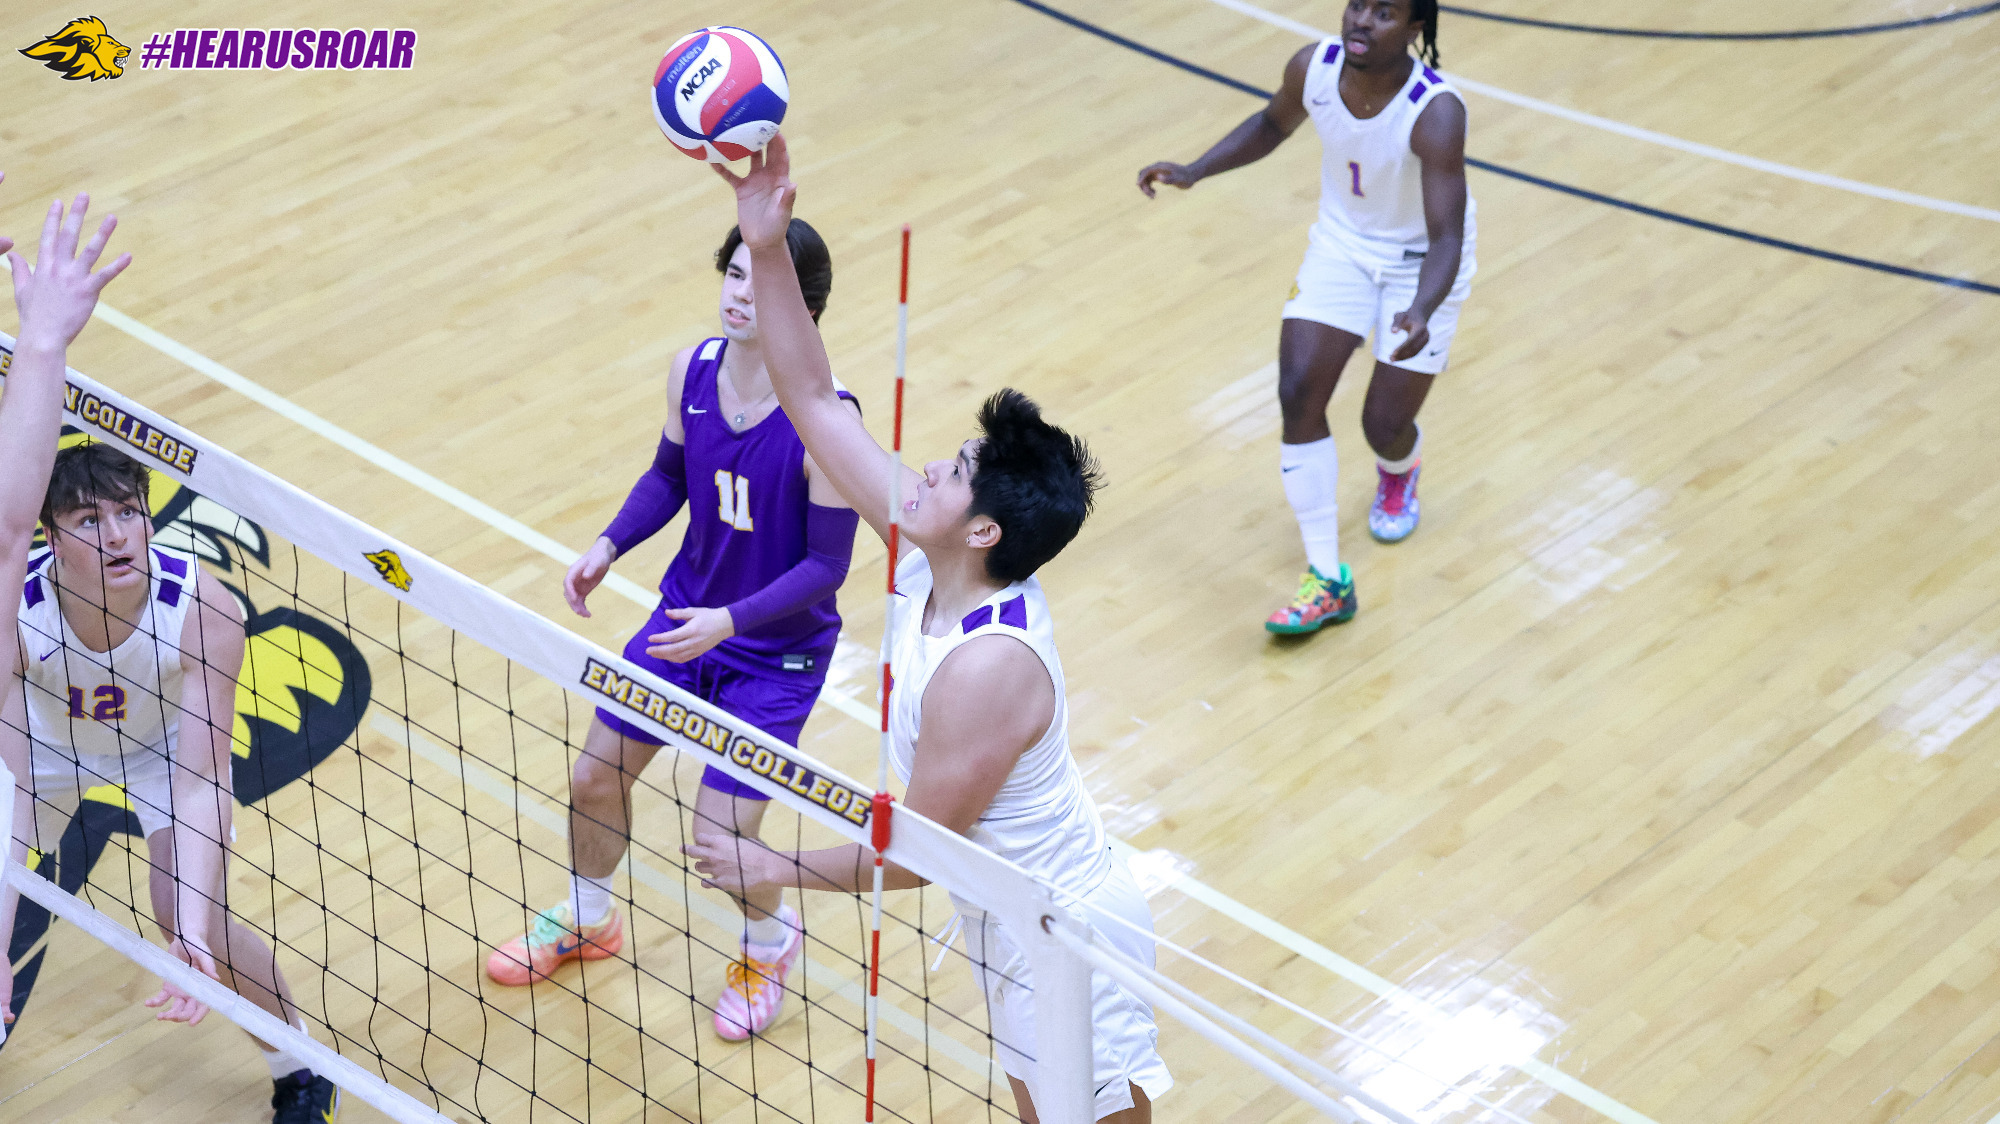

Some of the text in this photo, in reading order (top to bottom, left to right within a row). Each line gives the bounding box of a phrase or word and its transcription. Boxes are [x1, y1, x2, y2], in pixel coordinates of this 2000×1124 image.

[666, 45, 703, 84] molten
[680, 57, 723, 102] NCAA
[1348, 160, 1365, 198] 1
[82, 395, 196, 473] COLLEGE
[715, 469, 754, 532] 11
[66, 684, 127, 721] 12
[582, 659, 872, 825] EMERSON COLLEGE
